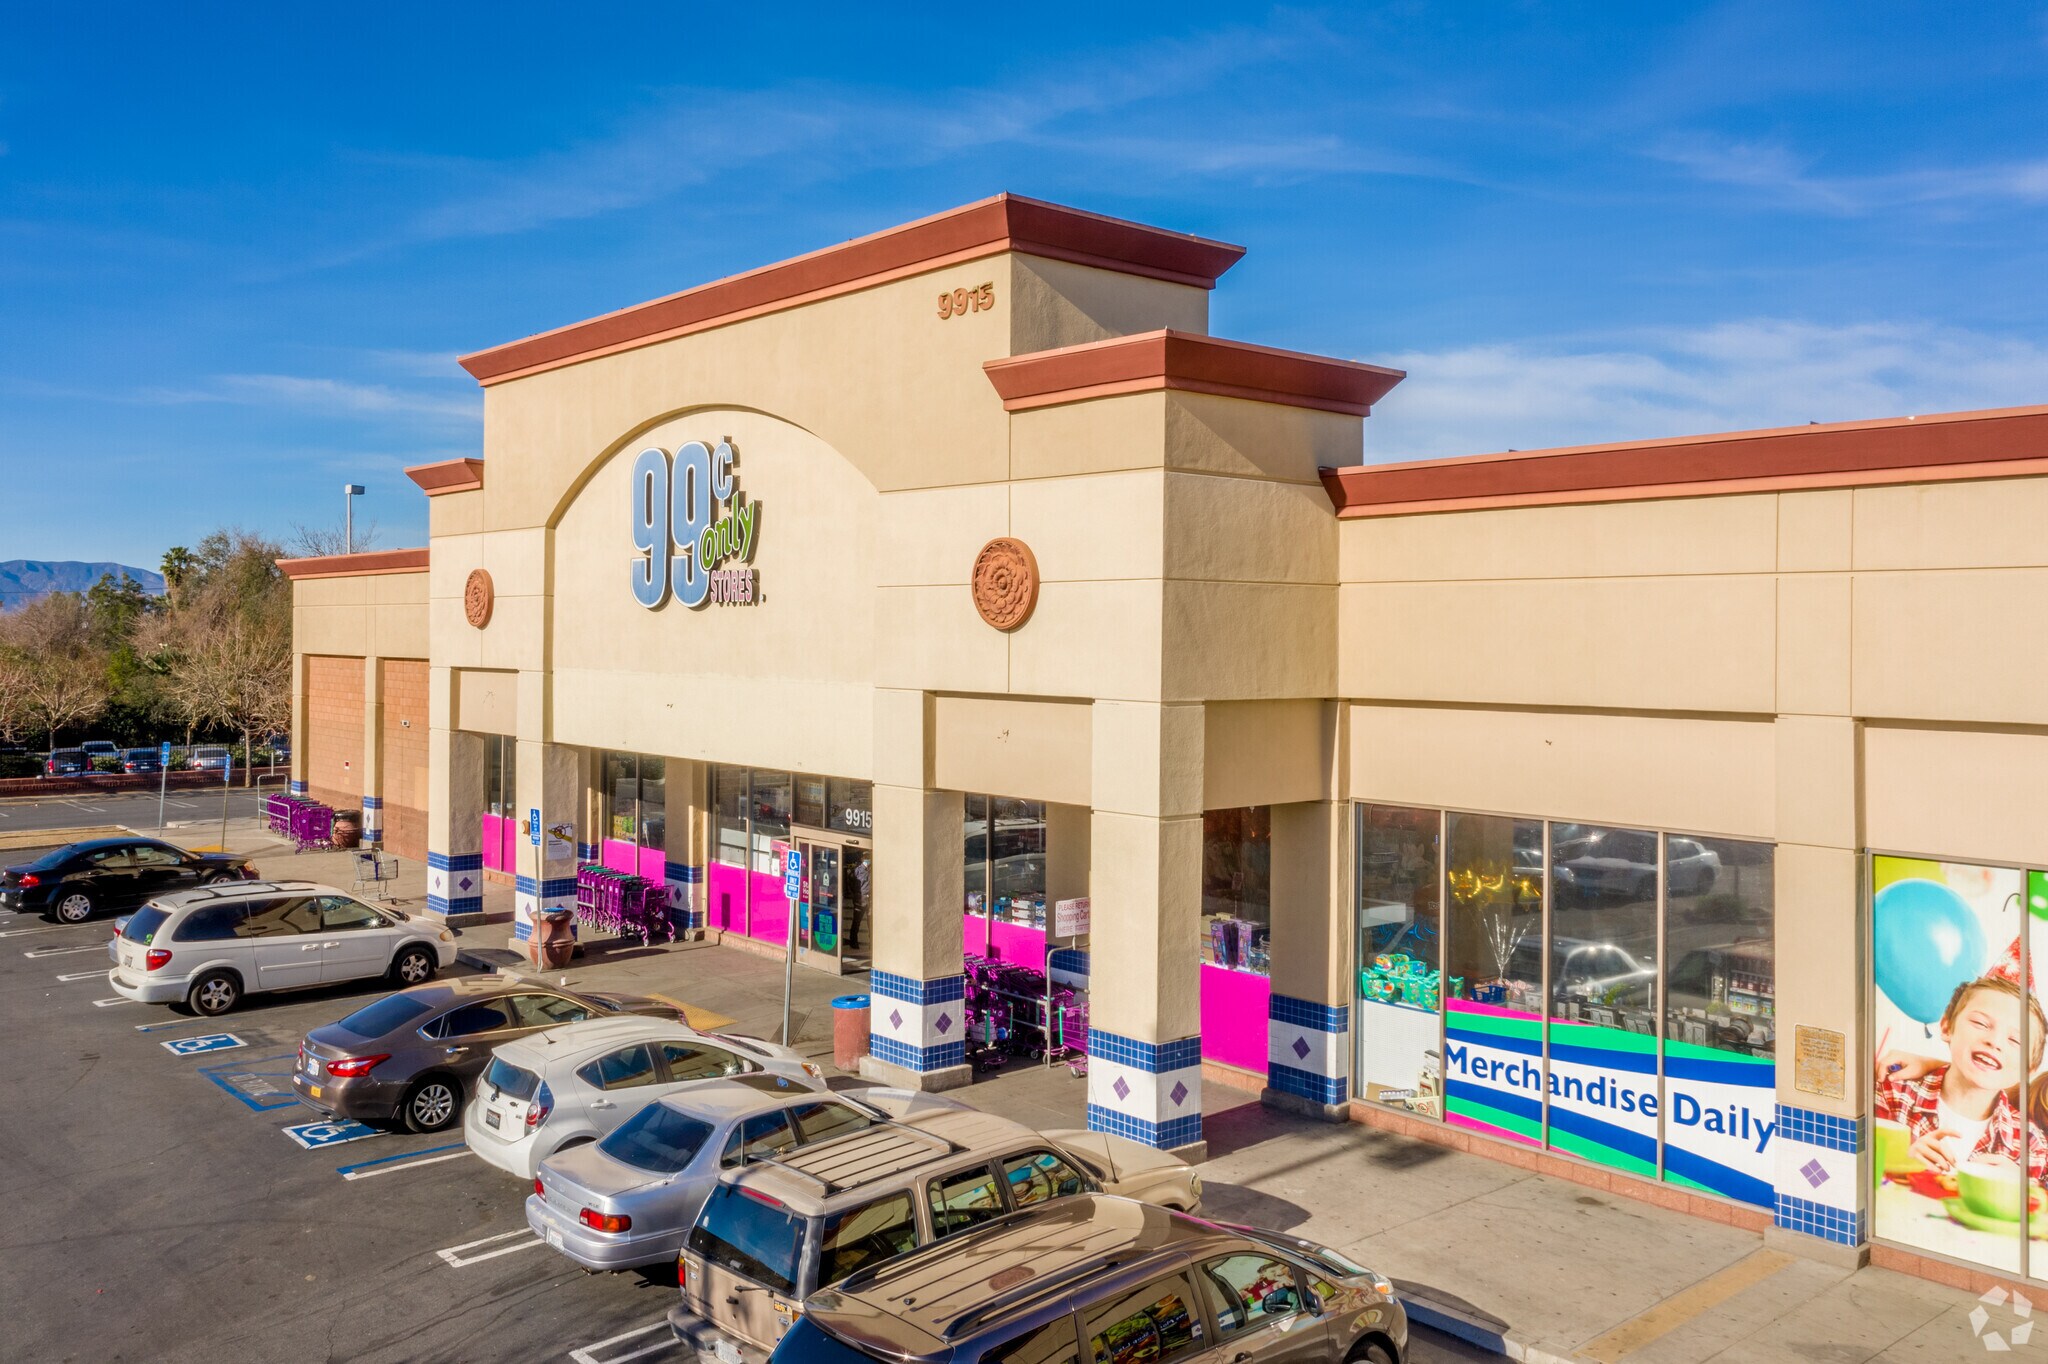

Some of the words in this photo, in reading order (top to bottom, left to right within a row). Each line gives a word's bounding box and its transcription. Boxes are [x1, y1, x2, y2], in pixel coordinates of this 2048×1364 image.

[937, 281, 995, 320] 9915
[700, 490, 755, 570] only
[710, 569, 753, 603] STORES
[845, 807, 872, 829] 9915
[1446, 1042, 1658, 1118] Merchandise
[1673, 1091, 1775, 1154] Daily
